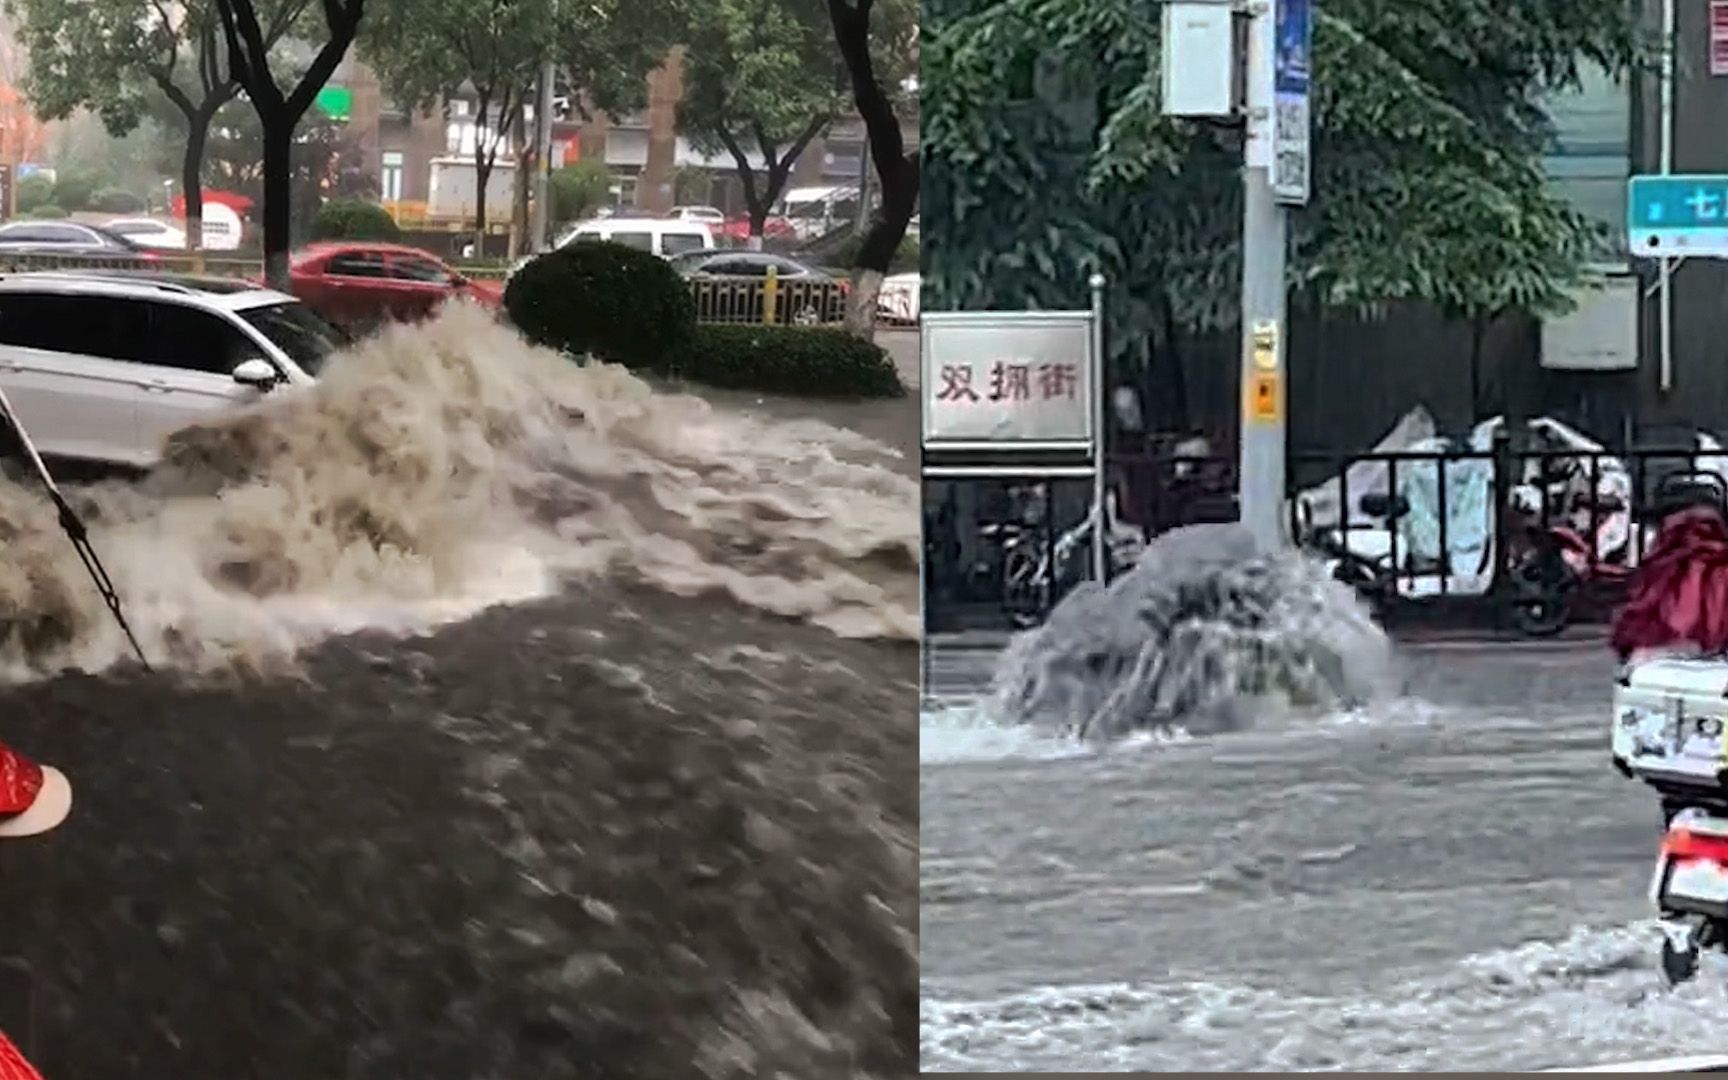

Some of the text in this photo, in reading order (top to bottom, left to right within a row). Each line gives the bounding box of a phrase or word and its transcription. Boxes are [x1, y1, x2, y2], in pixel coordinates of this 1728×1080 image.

[1684, 187, 1728, 218] 七
[936, 361, 1077, 402] 双拥街
